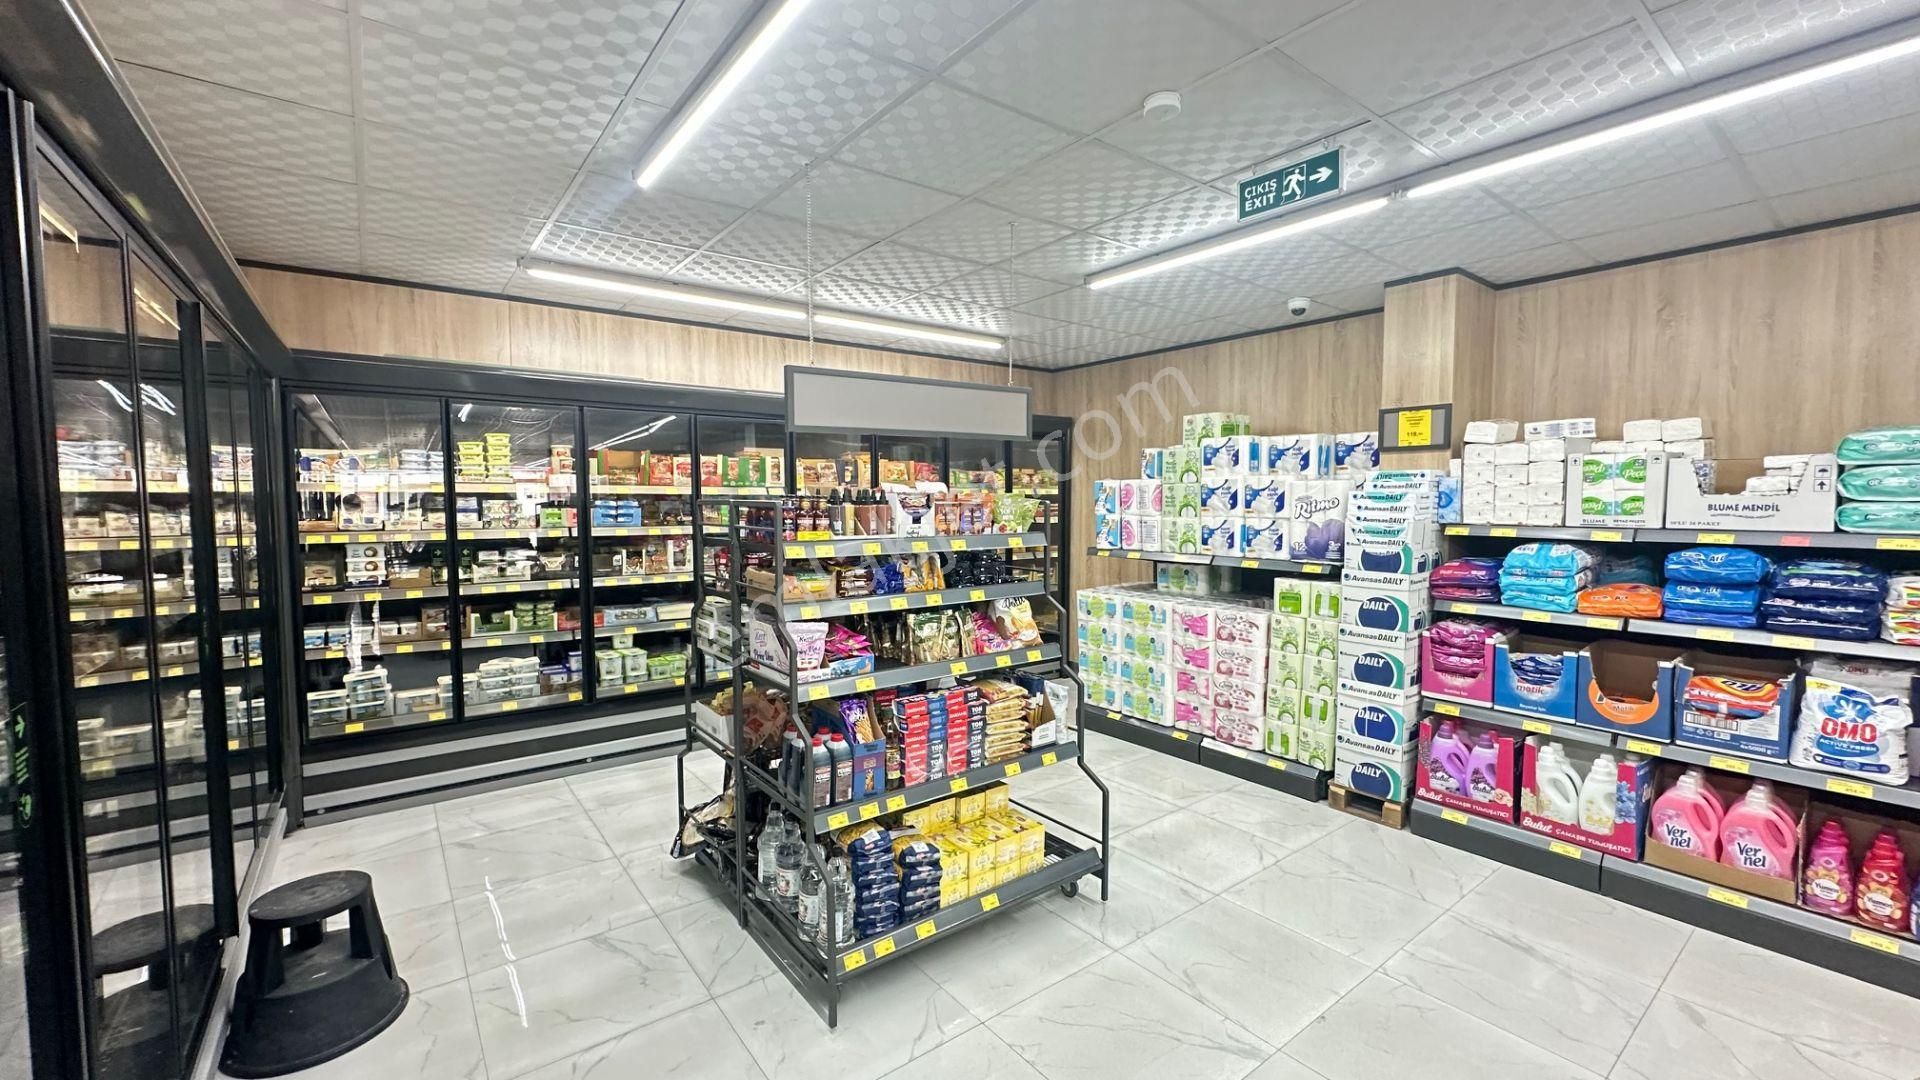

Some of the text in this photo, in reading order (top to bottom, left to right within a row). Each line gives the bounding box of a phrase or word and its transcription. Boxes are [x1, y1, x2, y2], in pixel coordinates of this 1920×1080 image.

[1244, 179, 1277, 199] ÇIKIŞ
[1245, 192, 1276, 212] EXIT
[1294, 496, 1340, 520] Ritmo
[1707, 502, 1781, 512] BLUME MENDİL
[1362, 601, 1389, 611] DAILY
[1358, 656, 1385, 667] DAILY
[967, 690, 978, 698] TON
[1358, 709, 1384, 722] DAILY
[1820, 718, 1878, 743] OMO
[970, 734, 982, 742] TON
[930, 758, 942, 766] TON
[1354, 764, 1381, 778] DAILY
[1417, 786, 1509, 818] Bulut ÇAMAŞIR YUMUŞATICI
[1522, 816, 1632, 854] Bulut ÇAMAŞIR YUMUŞATICI
[1665, 823, 1687, 839] Ver
[1670, 834, 1691, 849] nel
[1736, 842, 1762, 857] Ver
[1743, 854, 1766, 868] nel
